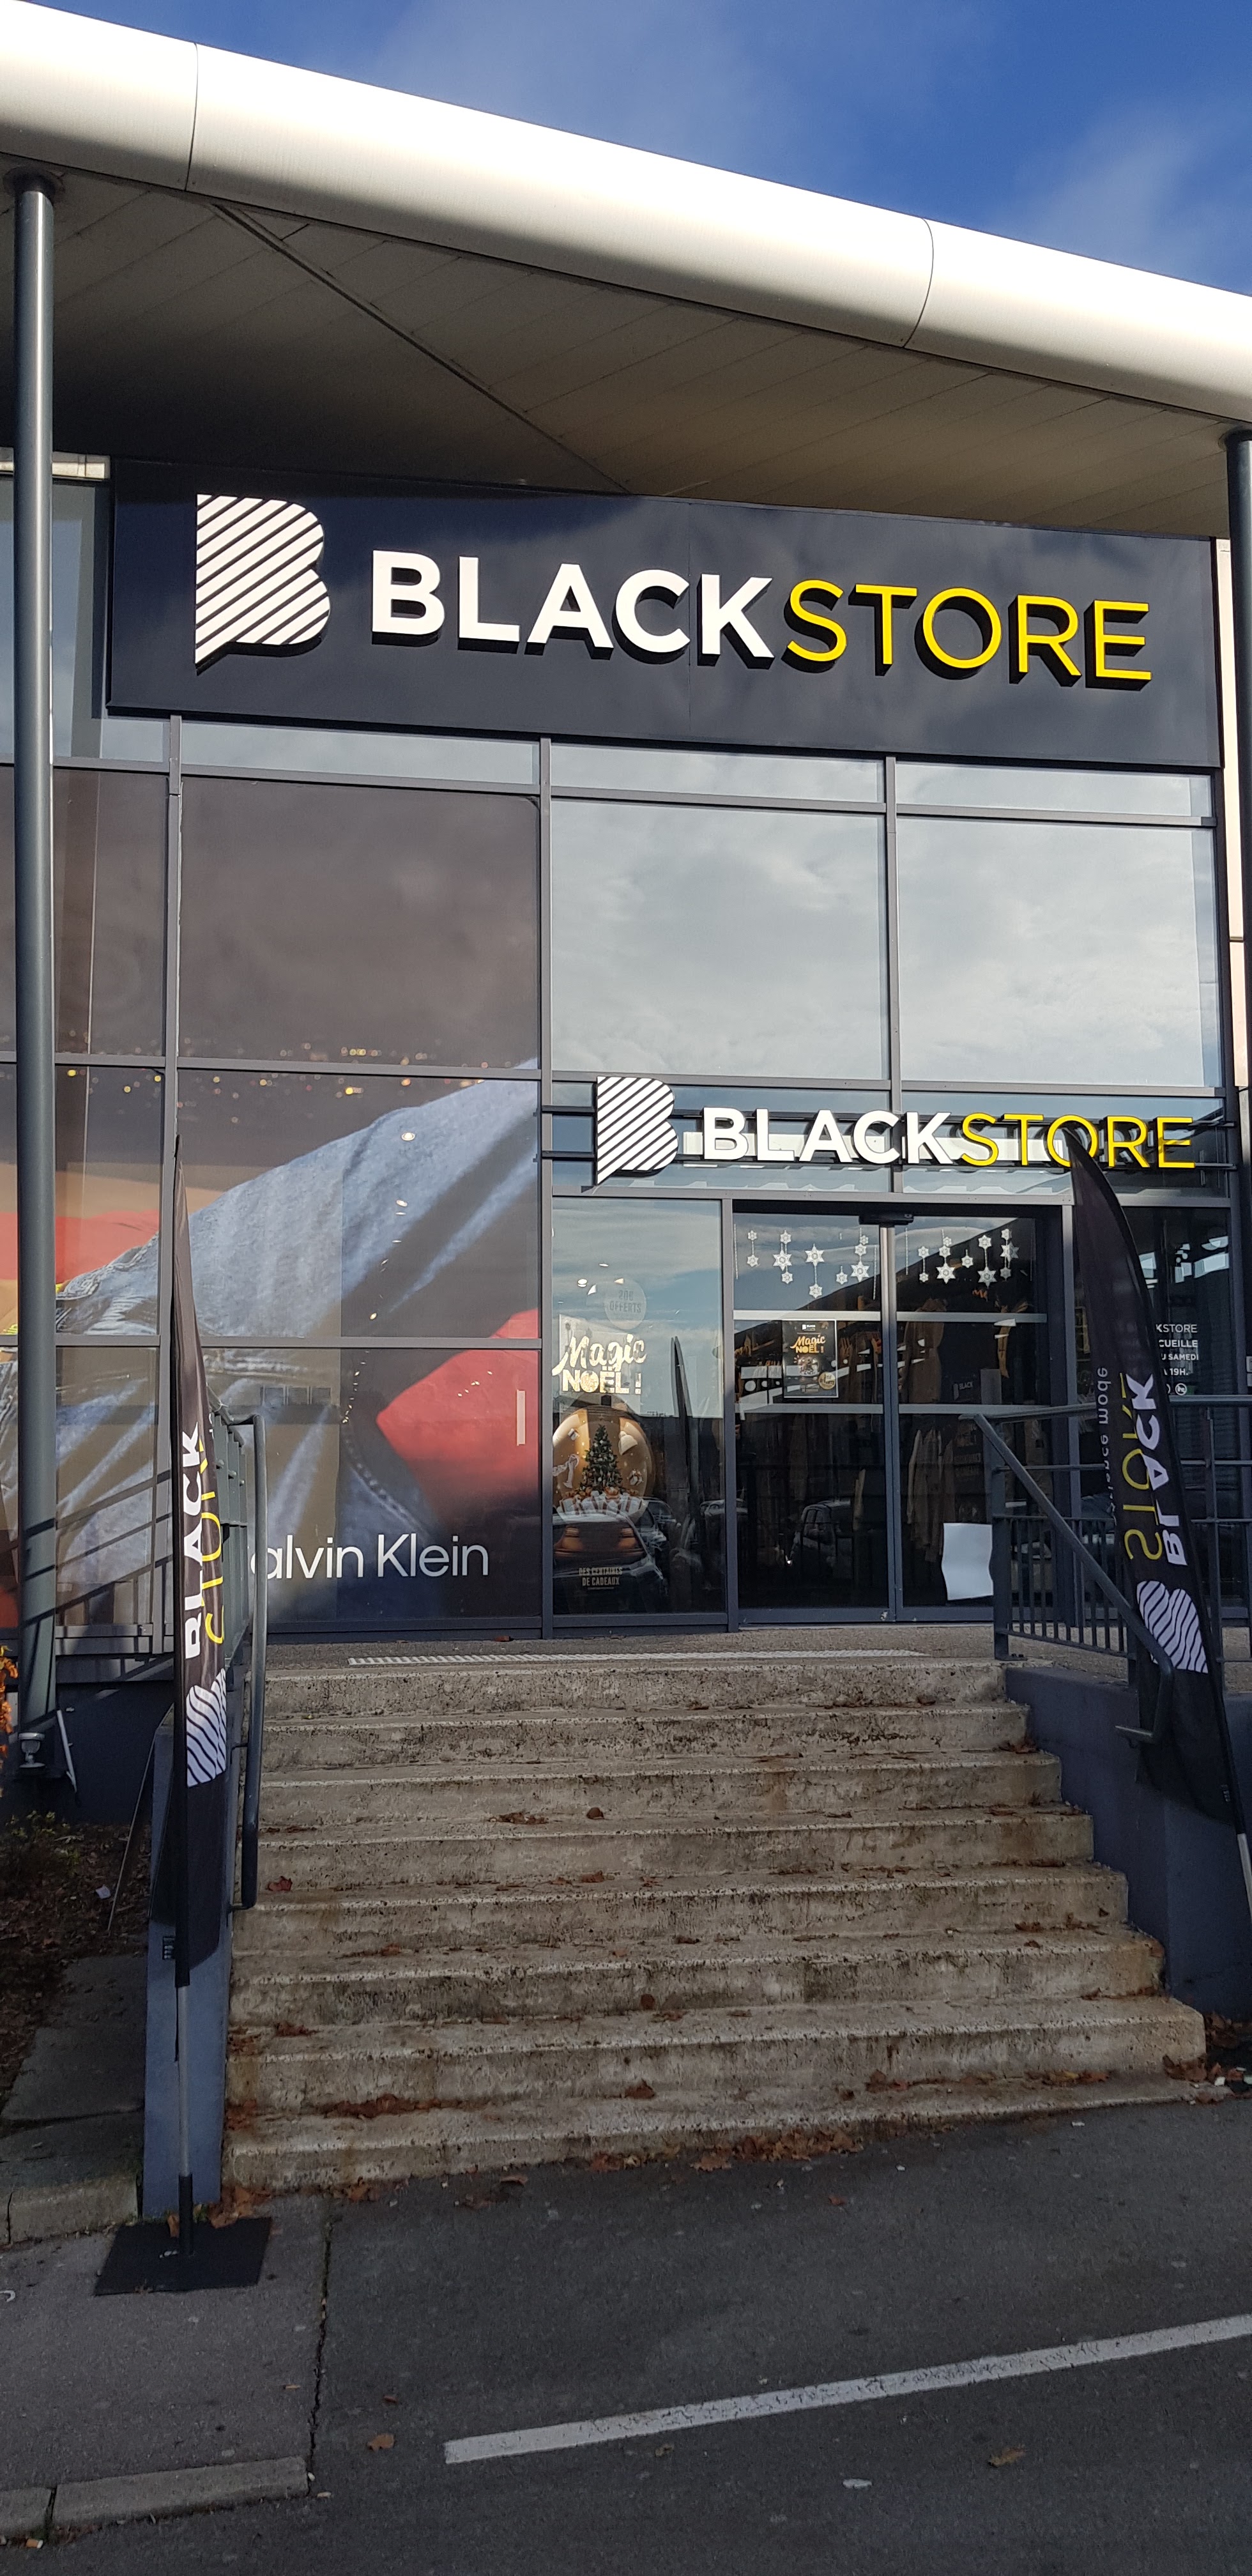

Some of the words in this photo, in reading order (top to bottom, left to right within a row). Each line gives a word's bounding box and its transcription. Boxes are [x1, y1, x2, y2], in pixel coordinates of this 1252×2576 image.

[372, 551, 1151, 682] BLACKSTORE
[703, 1107, 1196, 1169] BLACKSTORE
[551, 1333, 647, 1376] Magic
[790, 1334, 826, 1349] Magic
[250, 1534, 364, 1580] alvin
[378, 1533, 489, 1577] Klein
[582, 1577, 590, 1586] DE
[592, 1576, 620, 1586] CADEAUX
